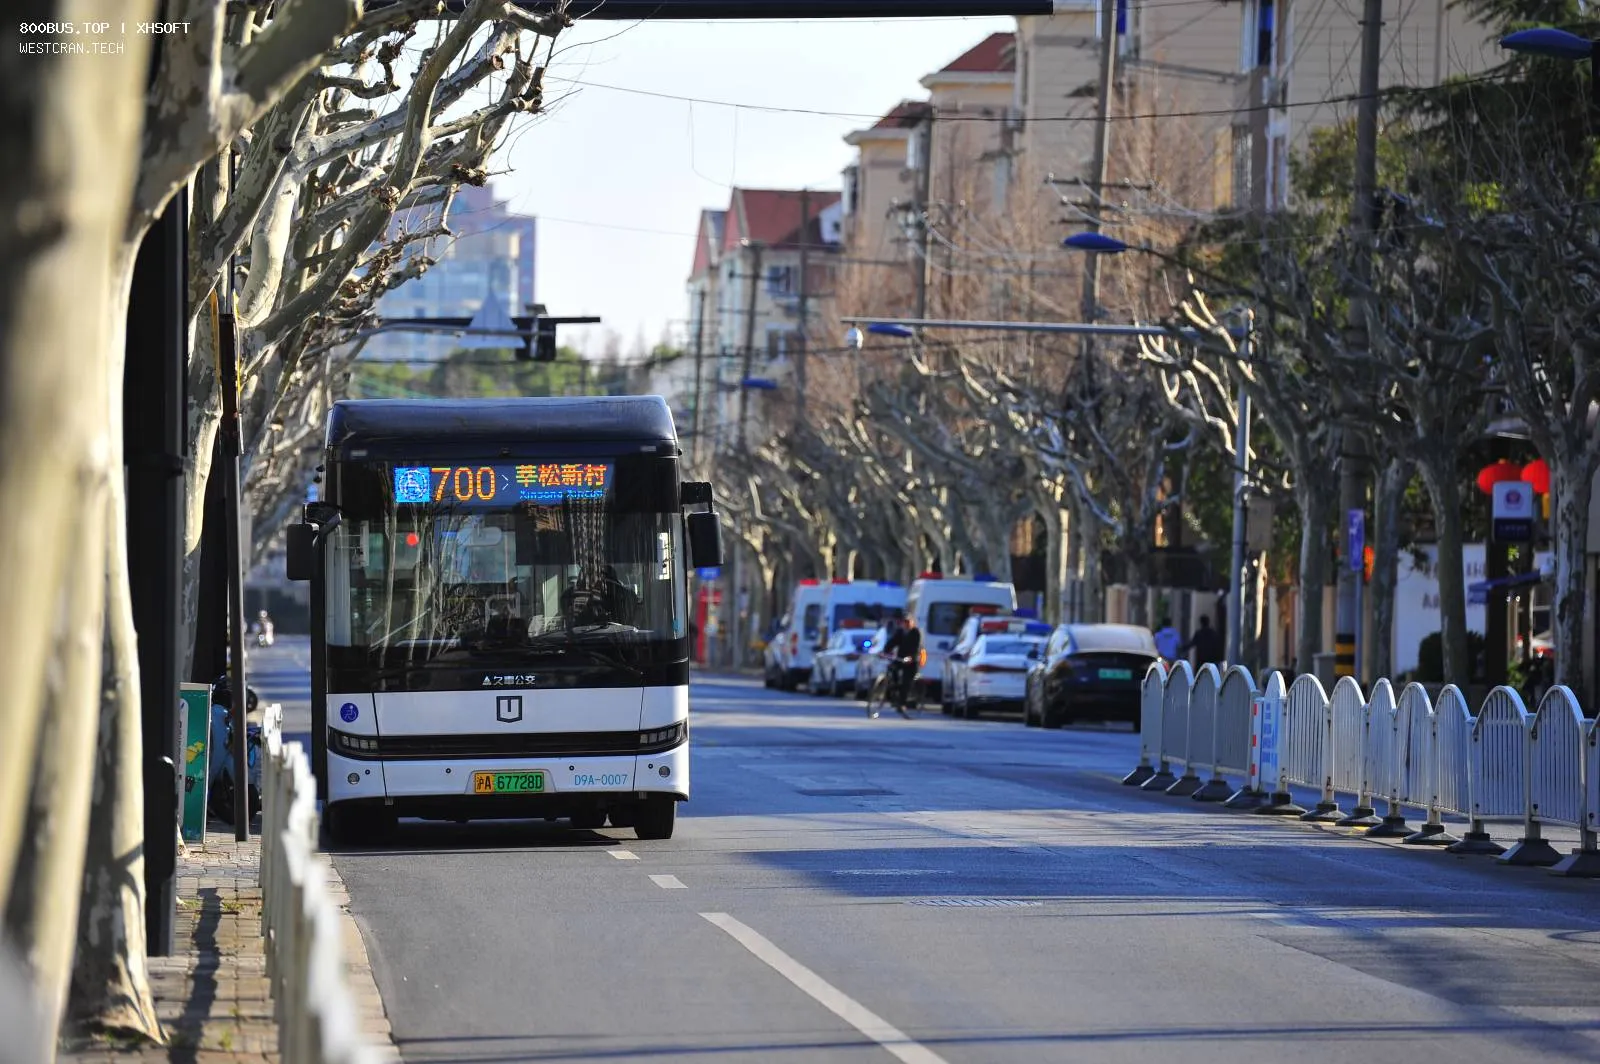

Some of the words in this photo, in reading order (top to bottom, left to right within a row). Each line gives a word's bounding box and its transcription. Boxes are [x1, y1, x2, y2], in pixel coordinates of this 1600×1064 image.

[431, 466, 496, 501] 700
[515, 463, 607, 487] 莘松新村
[574, 774, 628, 786] D9A-0007
